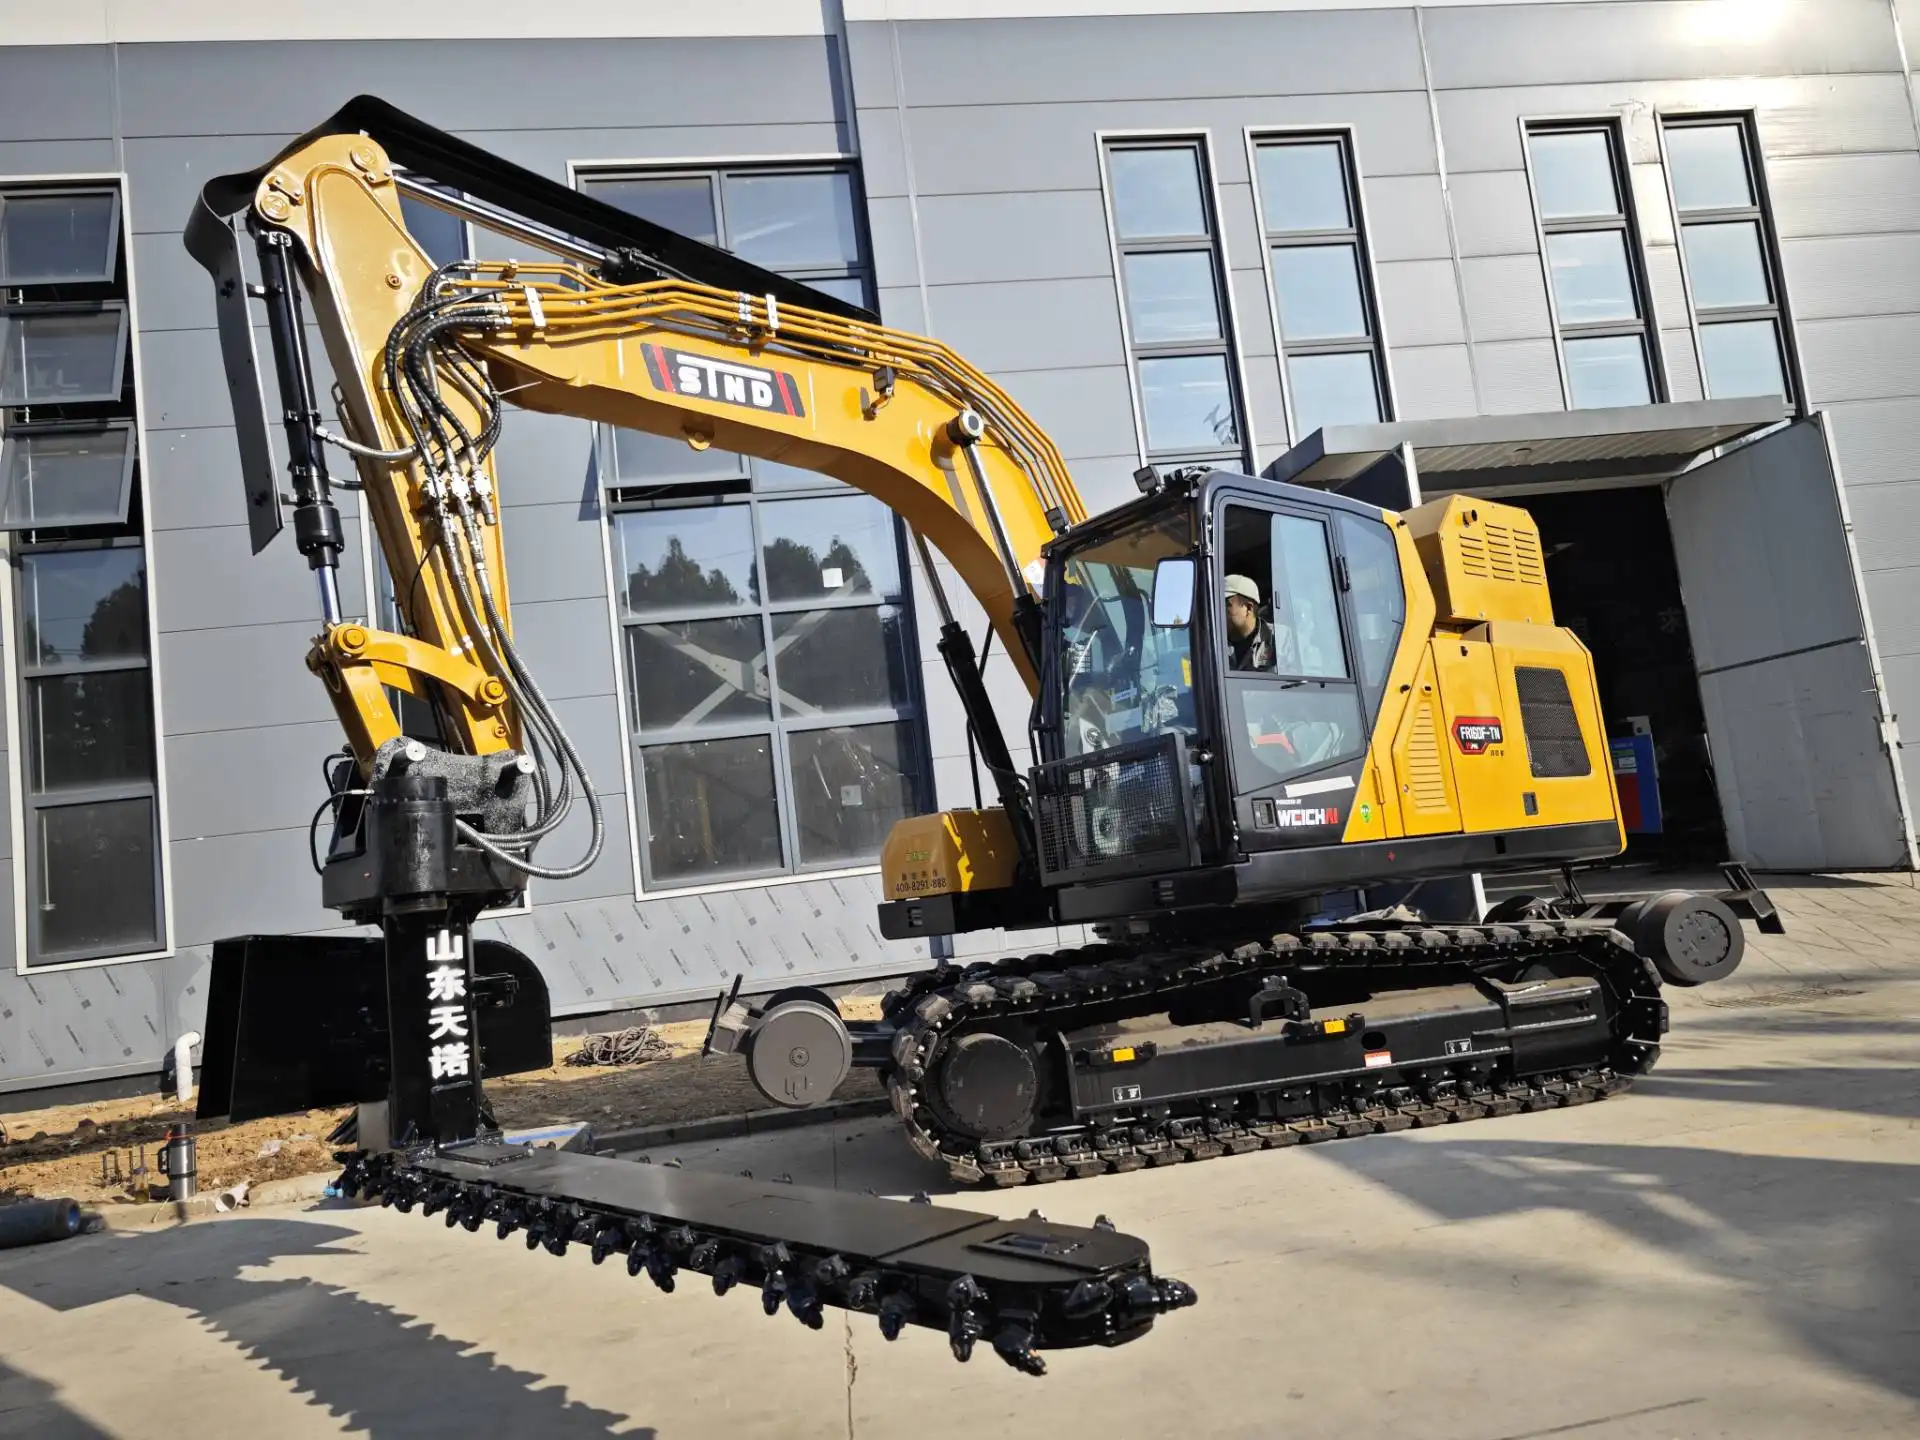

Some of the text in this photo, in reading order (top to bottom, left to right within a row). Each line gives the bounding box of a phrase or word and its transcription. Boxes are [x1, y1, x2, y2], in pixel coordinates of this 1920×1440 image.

[676, 353, 773, 408] STND
[1277, 808, 1339, 826] WEICHAI
[895, 878, 947, 893] 400-8291-888
[426, 929, 470, 1079] 山东天诺
